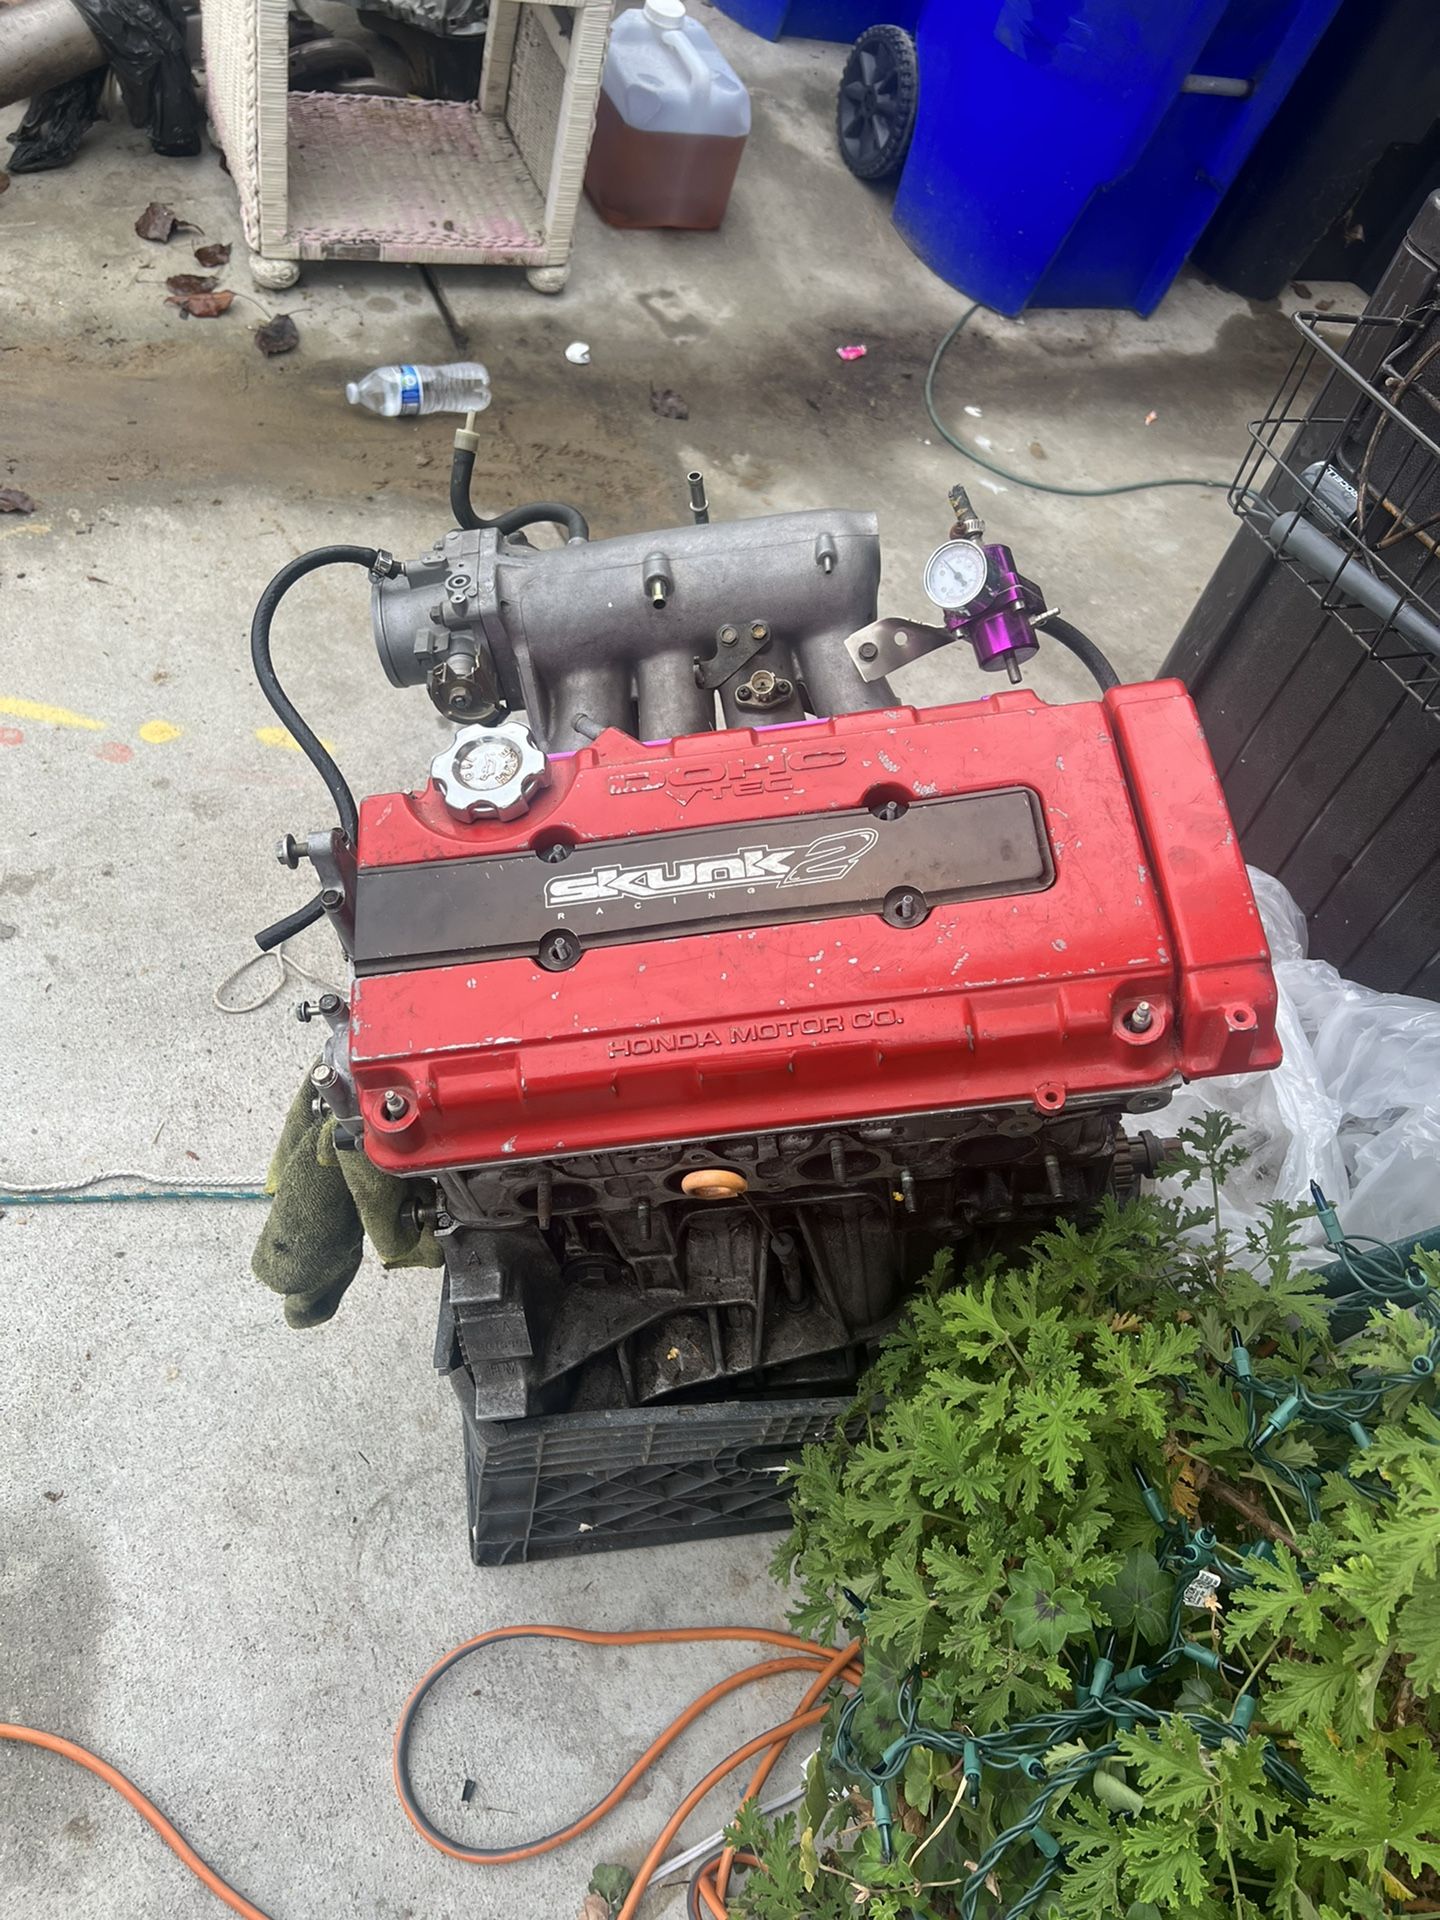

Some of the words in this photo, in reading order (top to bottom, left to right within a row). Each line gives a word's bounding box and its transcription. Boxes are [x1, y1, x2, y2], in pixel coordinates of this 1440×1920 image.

[608, 748, 847, 796] DOHC
[665, 777, 793, 806] VTEC
[557, 888, 756, 920] RACING
[608, 1035, 722, 1059] HONDA
[729, 1015, 845, 1044] MOTOR
[851, 1009, 905, 1029] CO.
